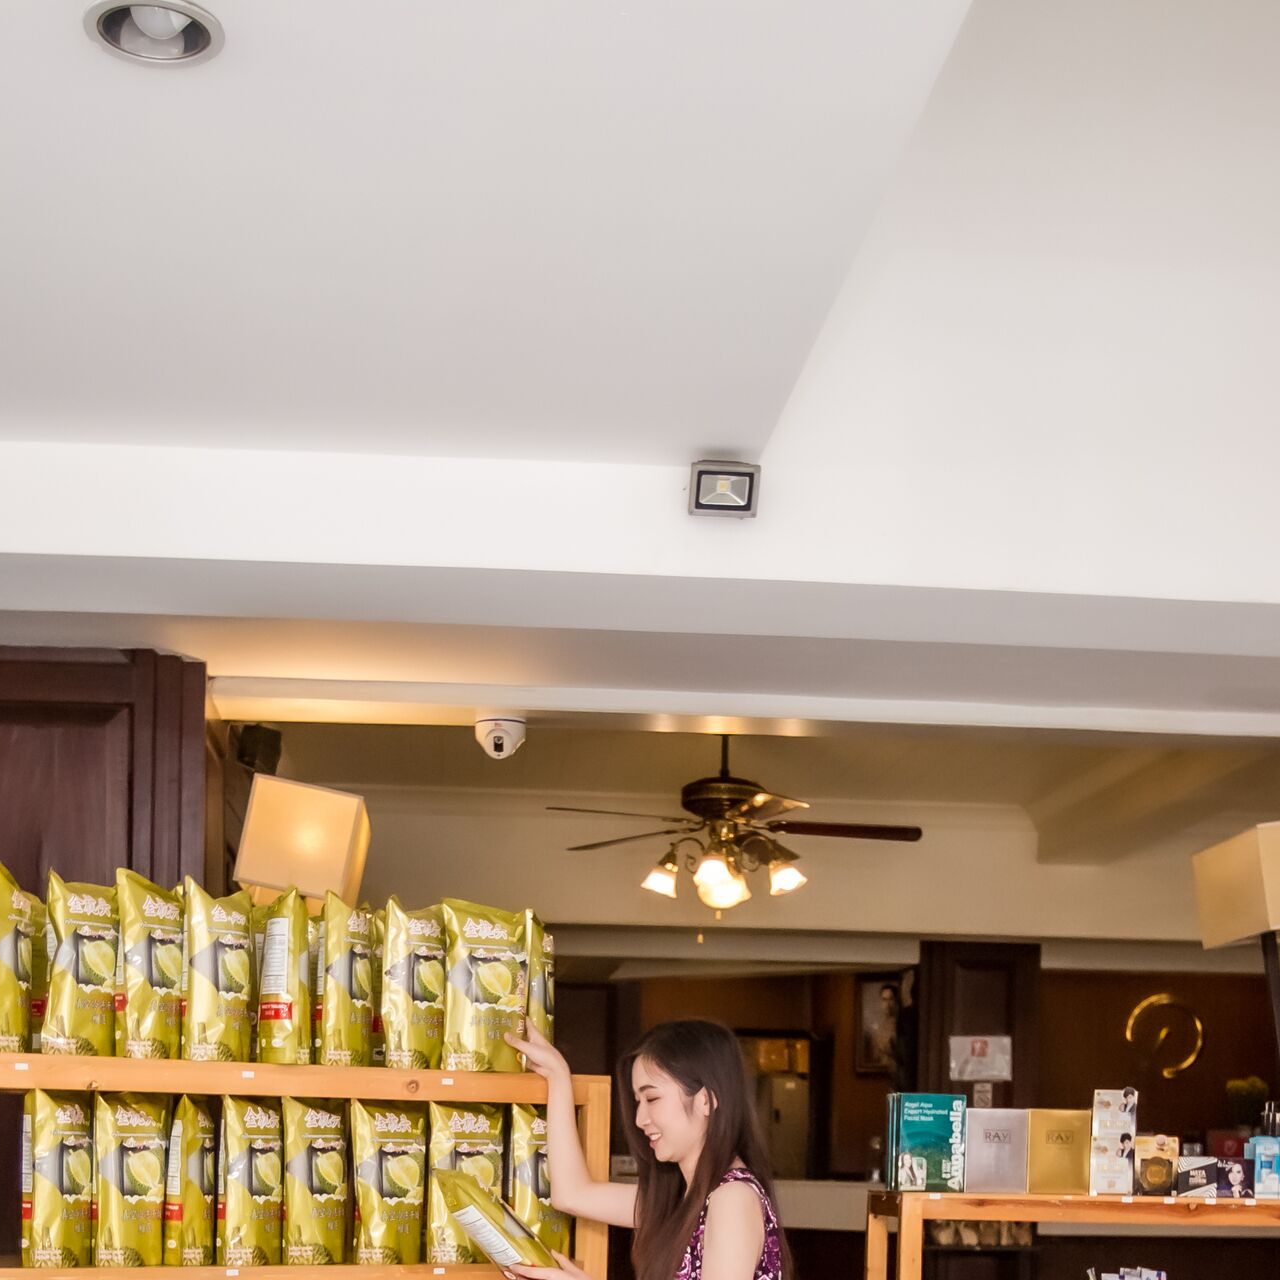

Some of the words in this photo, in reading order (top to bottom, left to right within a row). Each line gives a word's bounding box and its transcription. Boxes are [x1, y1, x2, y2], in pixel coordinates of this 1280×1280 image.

[448, 1112, 491, 1135] 金枕头
[947, 1099, 965, 1191] Annabella
[984, 1131, 1010, 1142] RAY
[1046, 1132, 1071, 1143] RAY
